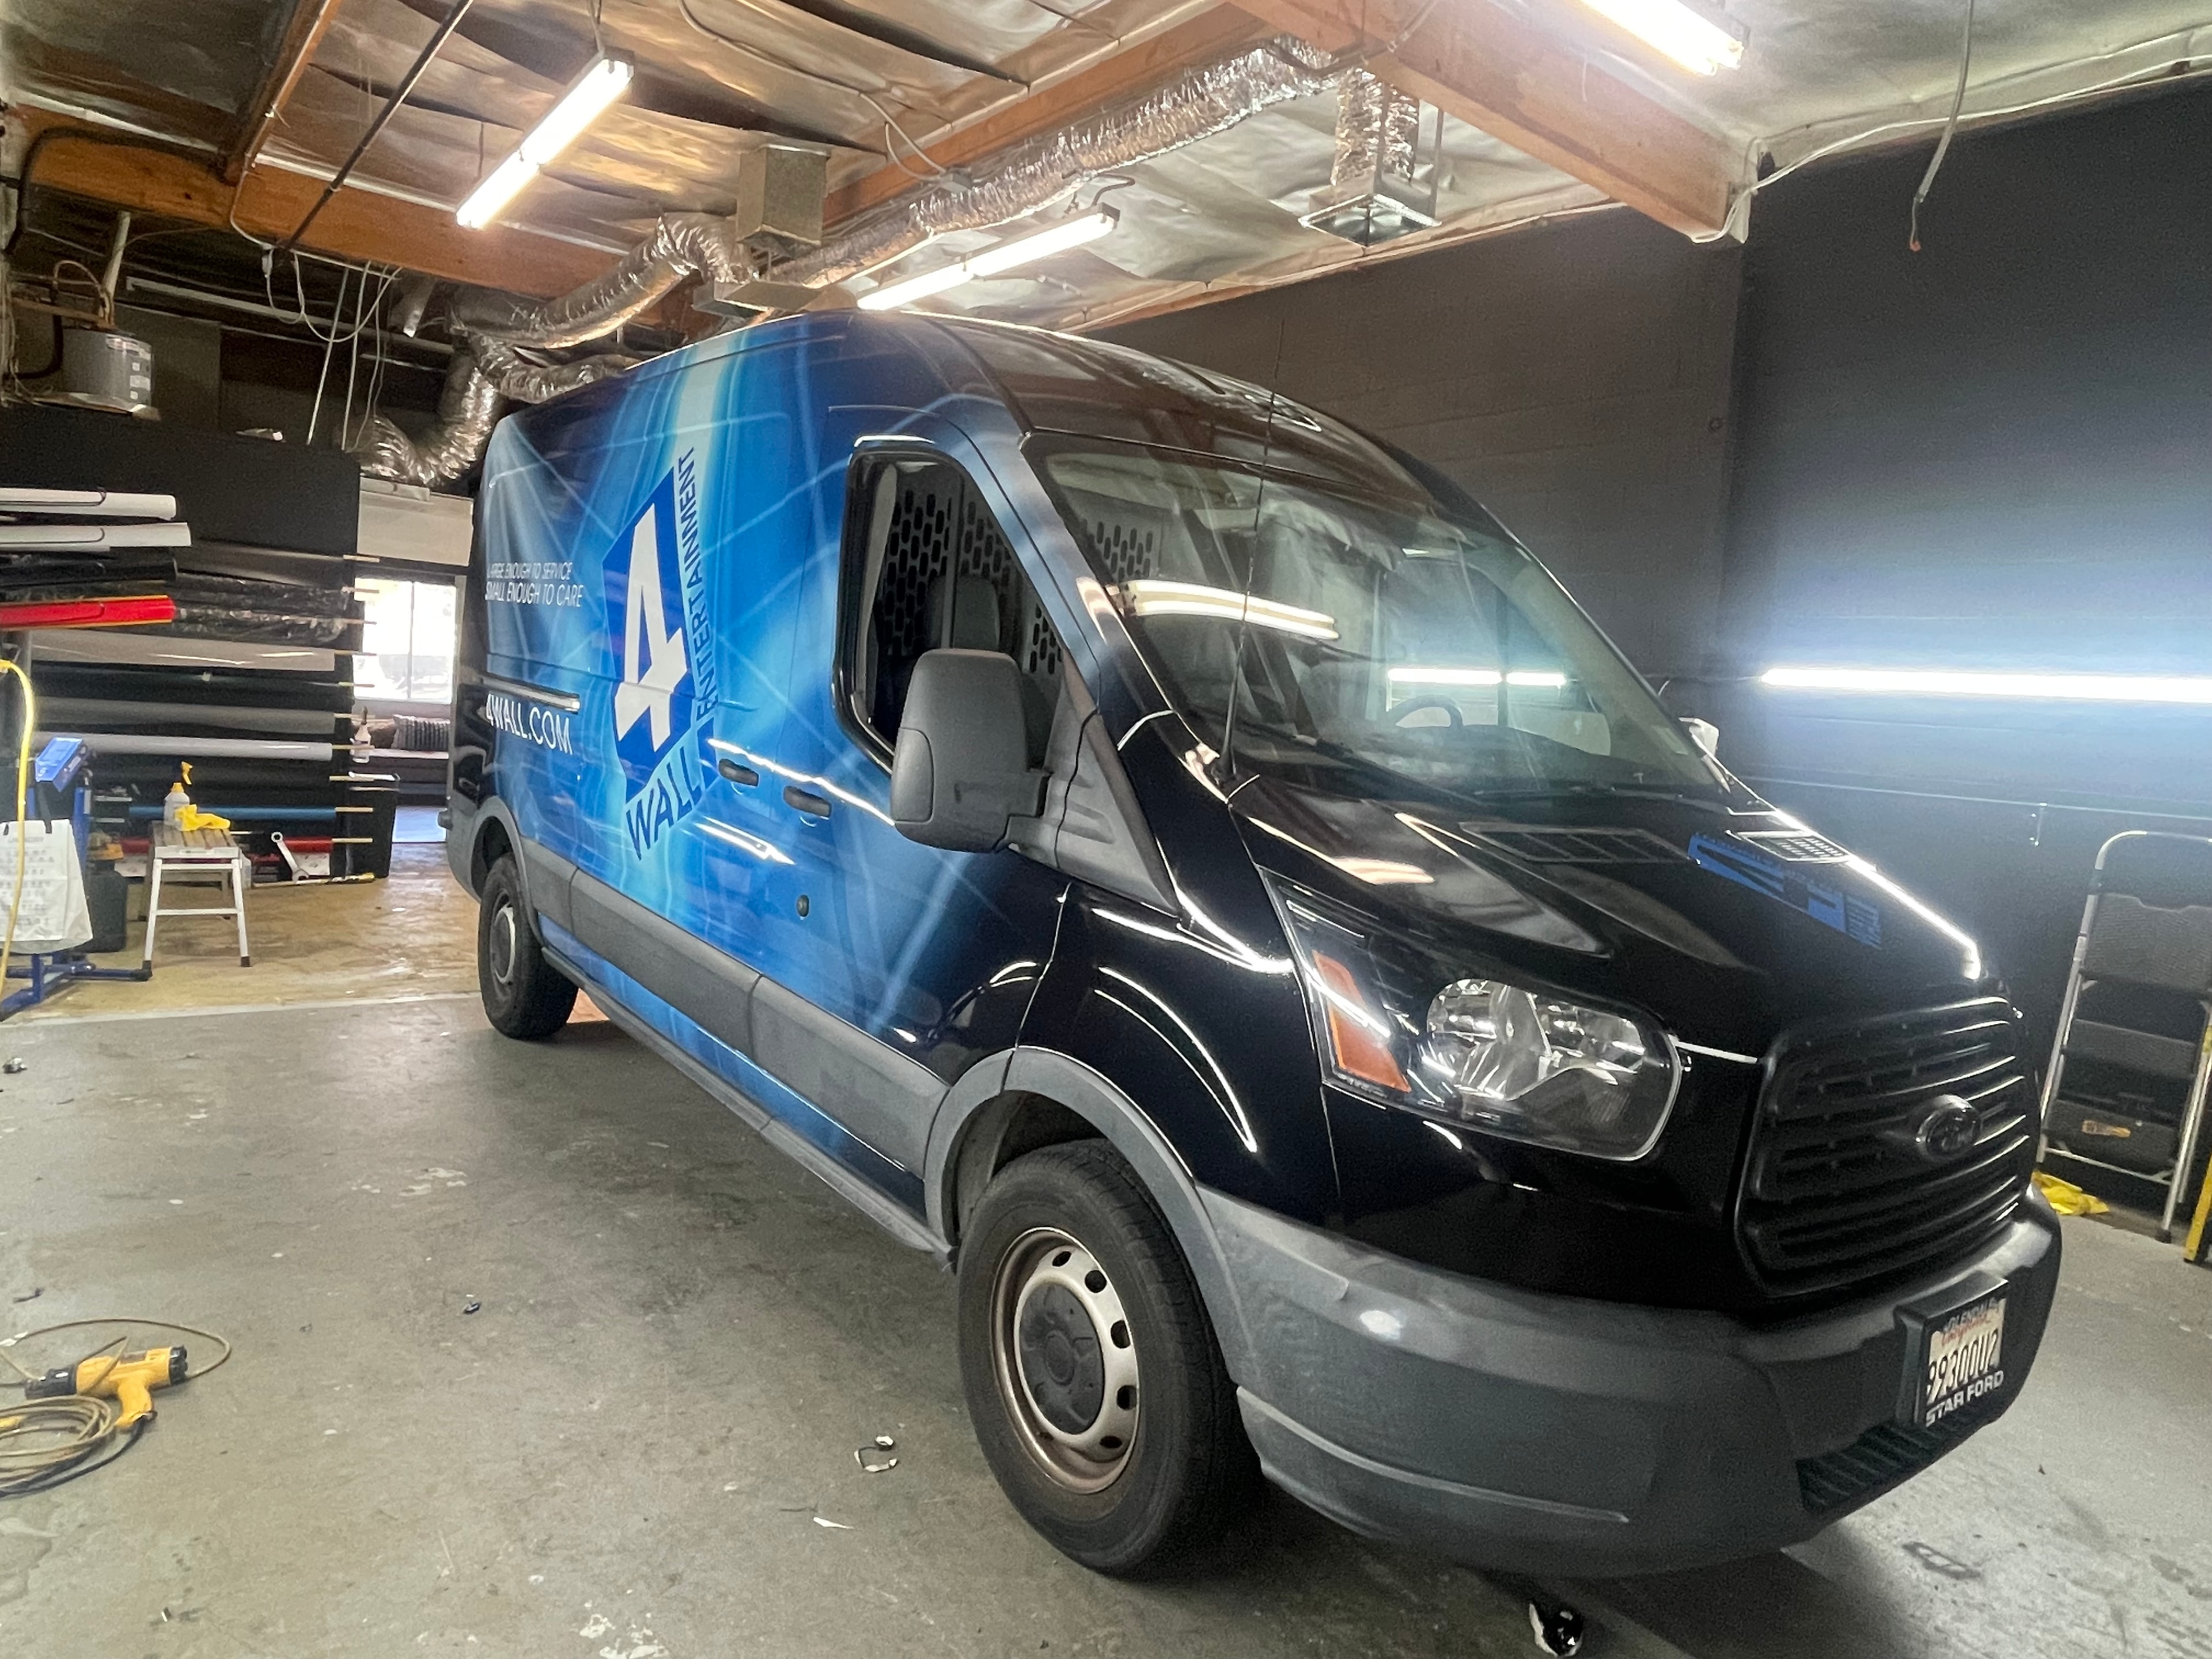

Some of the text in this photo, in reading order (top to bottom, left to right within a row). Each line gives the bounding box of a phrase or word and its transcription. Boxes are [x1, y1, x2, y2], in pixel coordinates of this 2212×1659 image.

[507, 582, 540, 604] ENOUGH
[542, 584, 554, 605] TO
[556, 584, 584, 607] CARE
[678, 446, 719, 721] ENTERTAINMENT
[486, 694, 573, 755] 4WALL.COM
[626, 747, 702, 861] WALL
[1926, 1370, 2004, 1427] STAR FORD
